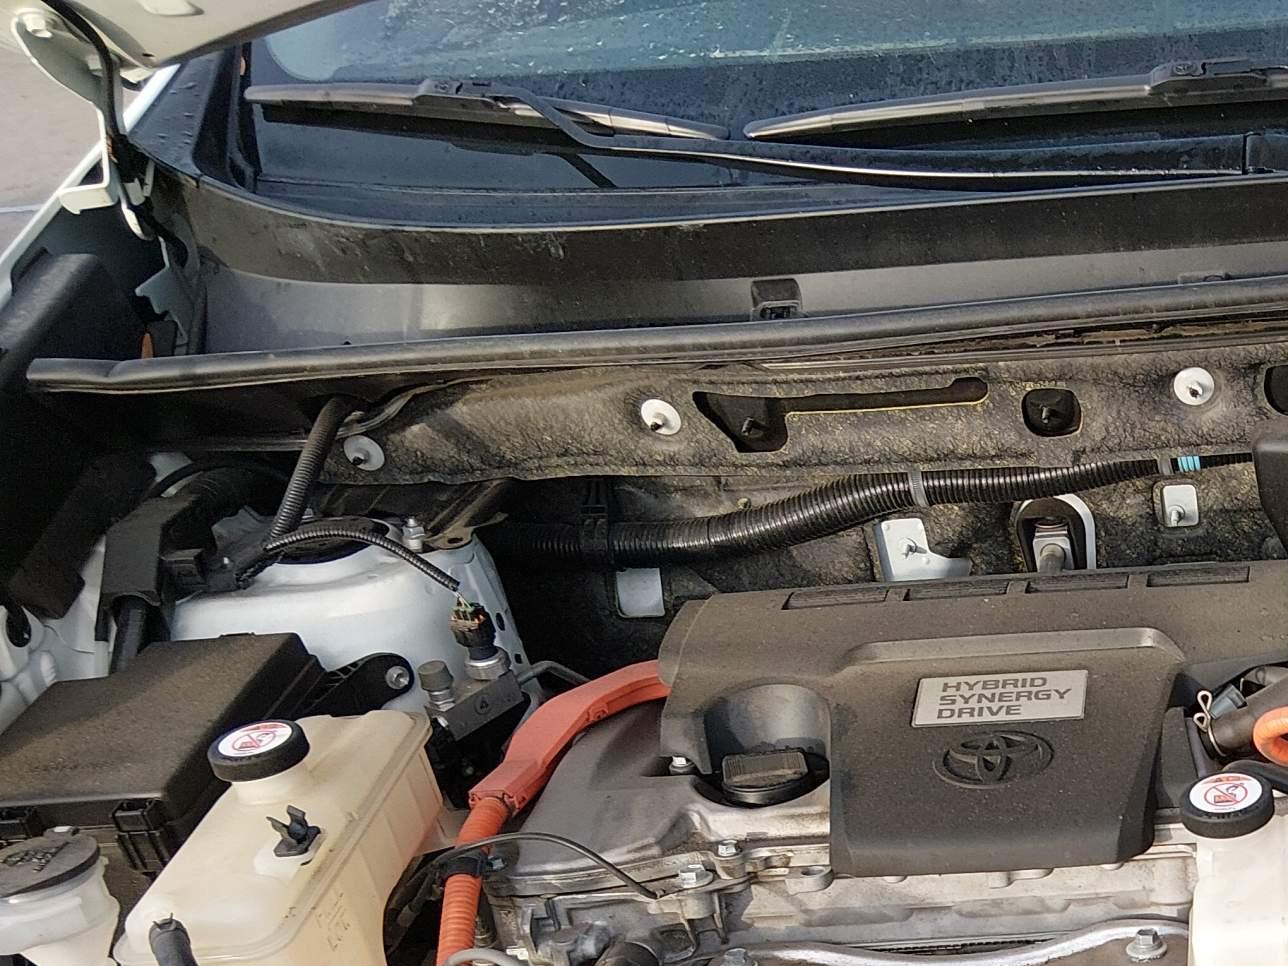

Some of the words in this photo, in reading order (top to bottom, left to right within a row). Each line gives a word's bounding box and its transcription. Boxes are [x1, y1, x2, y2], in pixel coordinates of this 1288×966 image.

[941, 676, 1048, 693] HYBRID
[939, 688, 1072, 706] SYNERGY
[937, 704, 1022, 719] DRIVE
